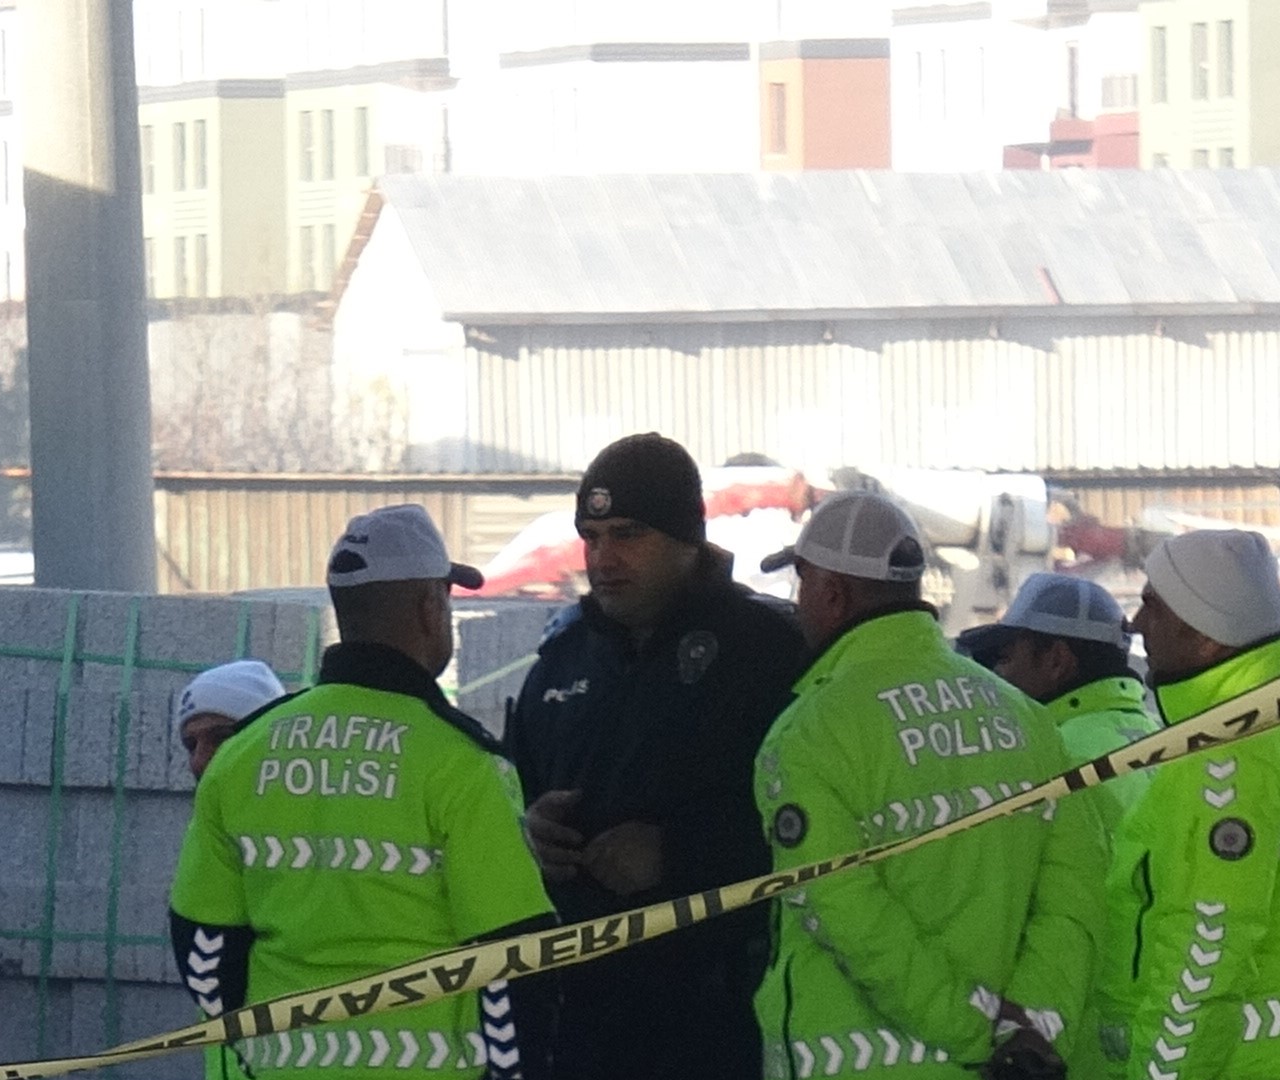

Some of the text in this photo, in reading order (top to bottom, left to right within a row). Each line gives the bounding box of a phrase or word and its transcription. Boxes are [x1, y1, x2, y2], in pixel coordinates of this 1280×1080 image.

[270, 714, 408, 754] TRAFİK
[898, 716, 1025, 766] POLİS
[256, 758, 398, 799] POLİSİ
